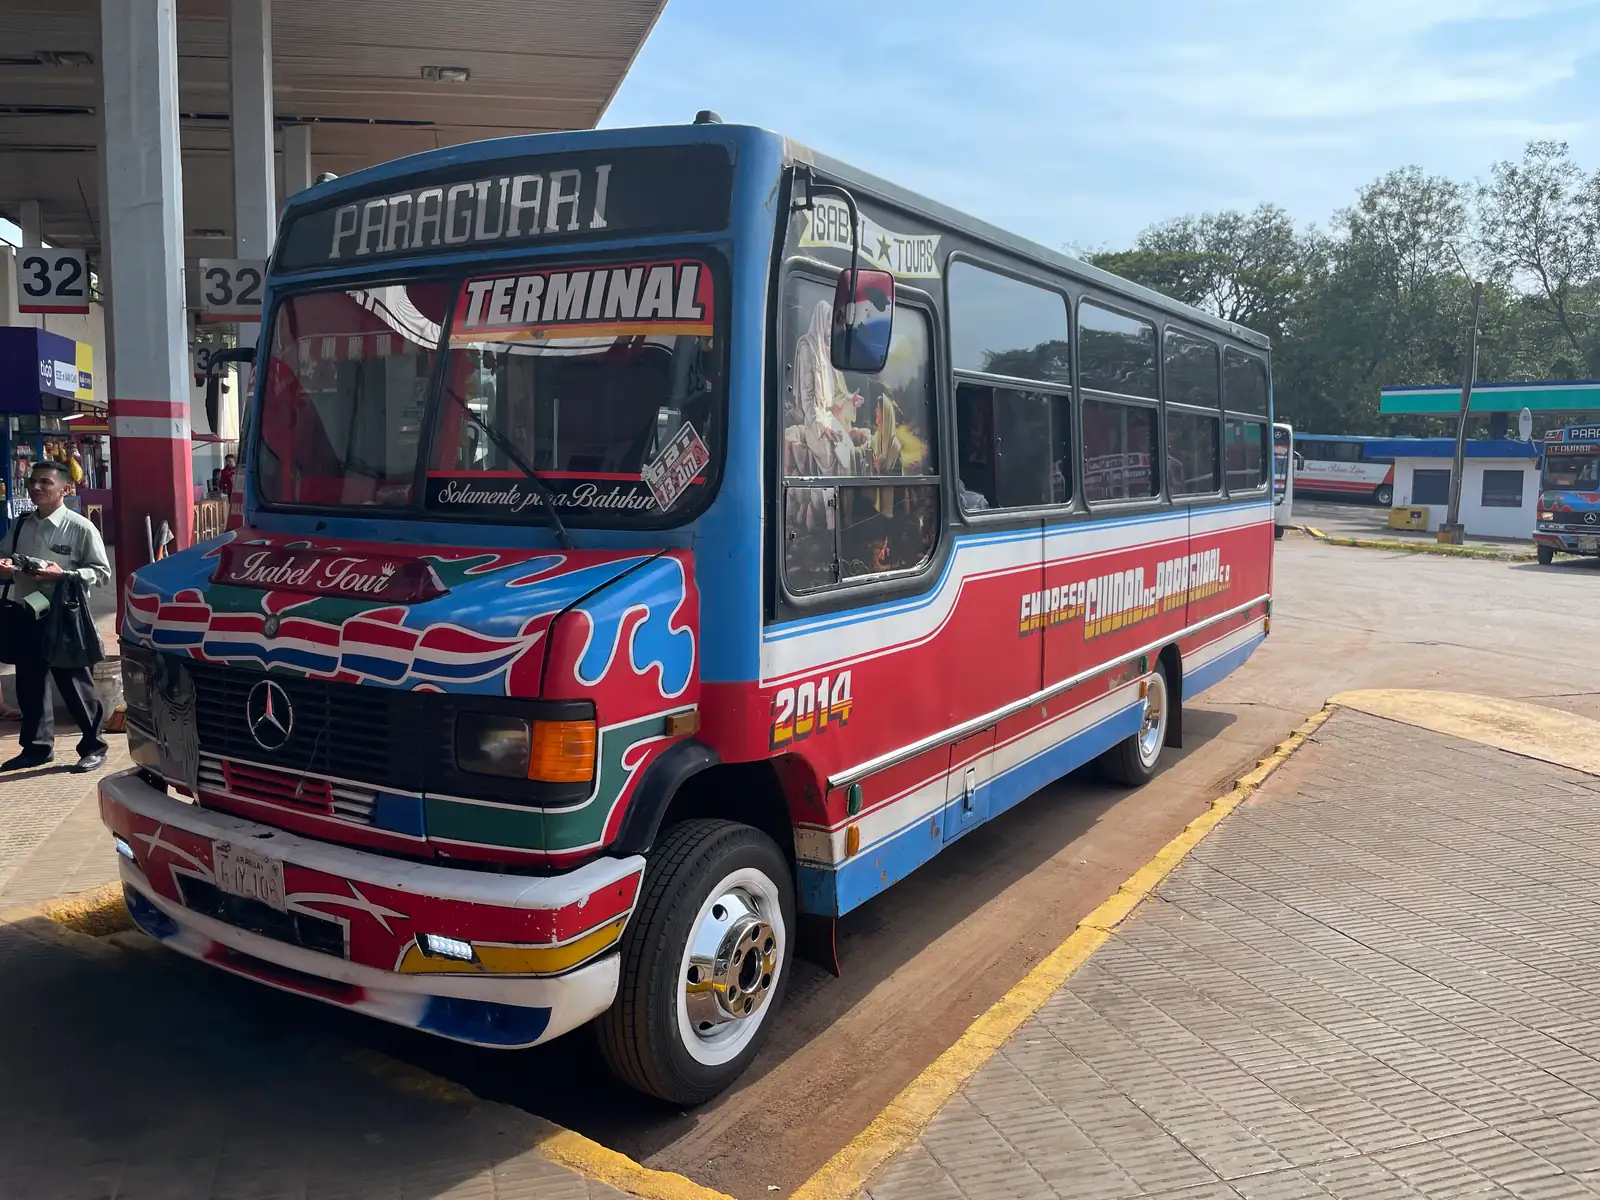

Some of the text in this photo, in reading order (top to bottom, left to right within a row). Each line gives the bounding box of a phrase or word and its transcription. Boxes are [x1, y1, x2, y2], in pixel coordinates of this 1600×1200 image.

[329, 164, 612, 259] PARAGUARI
[810, 203, 933, 273] ISABL TOURS
[22, 256, 84, 297] 32
[205, 267, 262, 306] 32
[464, 264, 703, 328] TERMINAL
[438, 480, 520, 505] Solamente
[511, 492, 568, 512] paa
[230, 551, 392, 594] Isabel Tour
[1019, 581, 1085, 632] EMPRESA
[1083, 567, 1145, 640] CIUDAD
[1154, 548, 1220, 616] PARAGUARI
[772, 669, 853, 745] 2014
